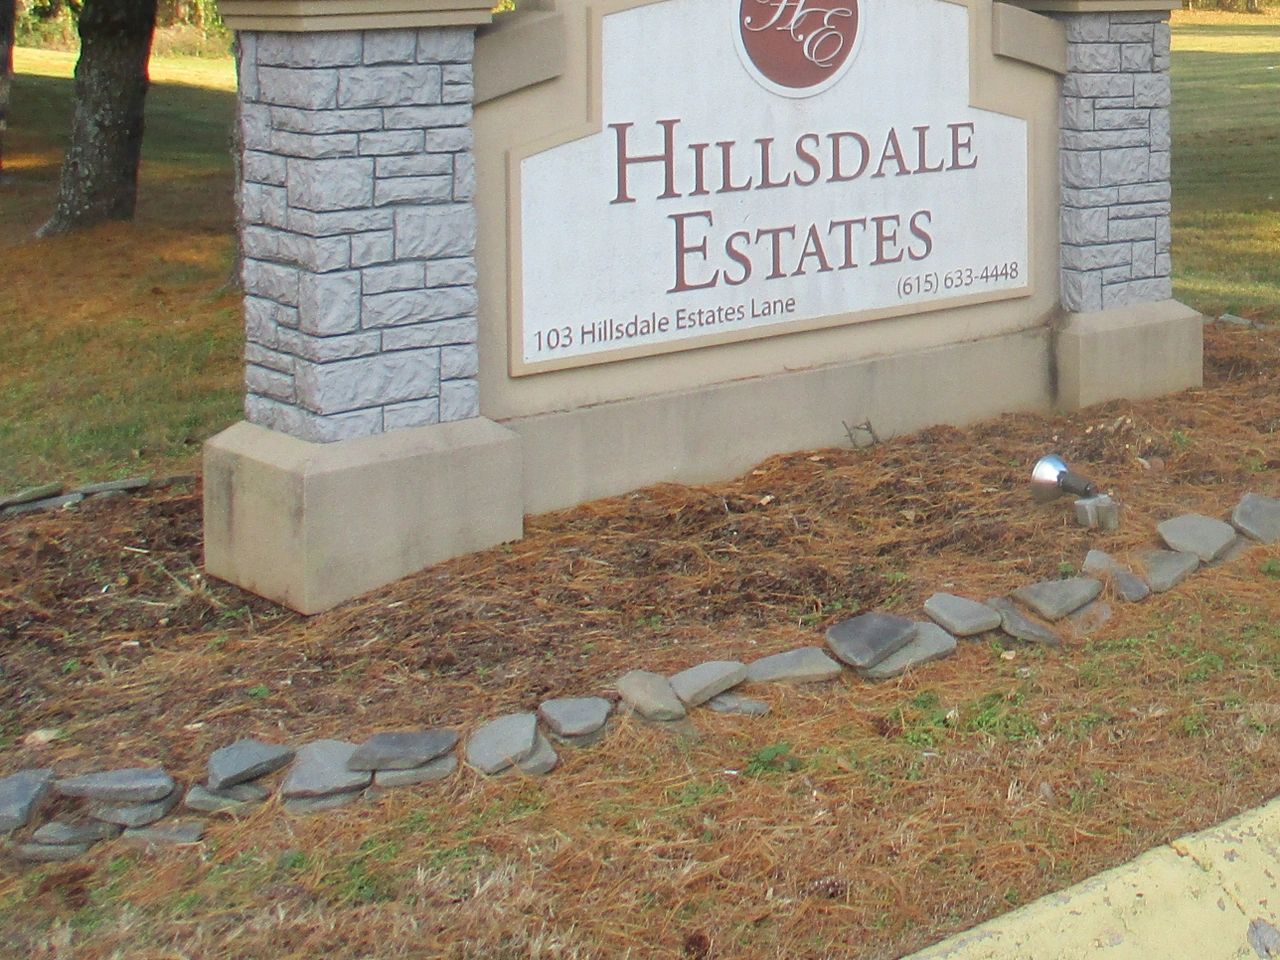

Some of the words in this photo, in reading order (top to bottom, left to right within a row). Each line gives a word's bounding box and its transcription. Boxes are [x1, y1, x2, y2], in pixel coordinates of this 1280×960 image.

[608, 118, 979, 205] HILLSDALE
[666, 210, 934, 294] ESTATES
[896, 270, 940, 299] (615)
[943, 260, 1020, 290] 633-4448
[533, 326, 574, 352] 103
[580, 312, 670, 346] Hillsdale
[675, 302, 746, 331] Estates
[750, 295, 797, 320] Lane
